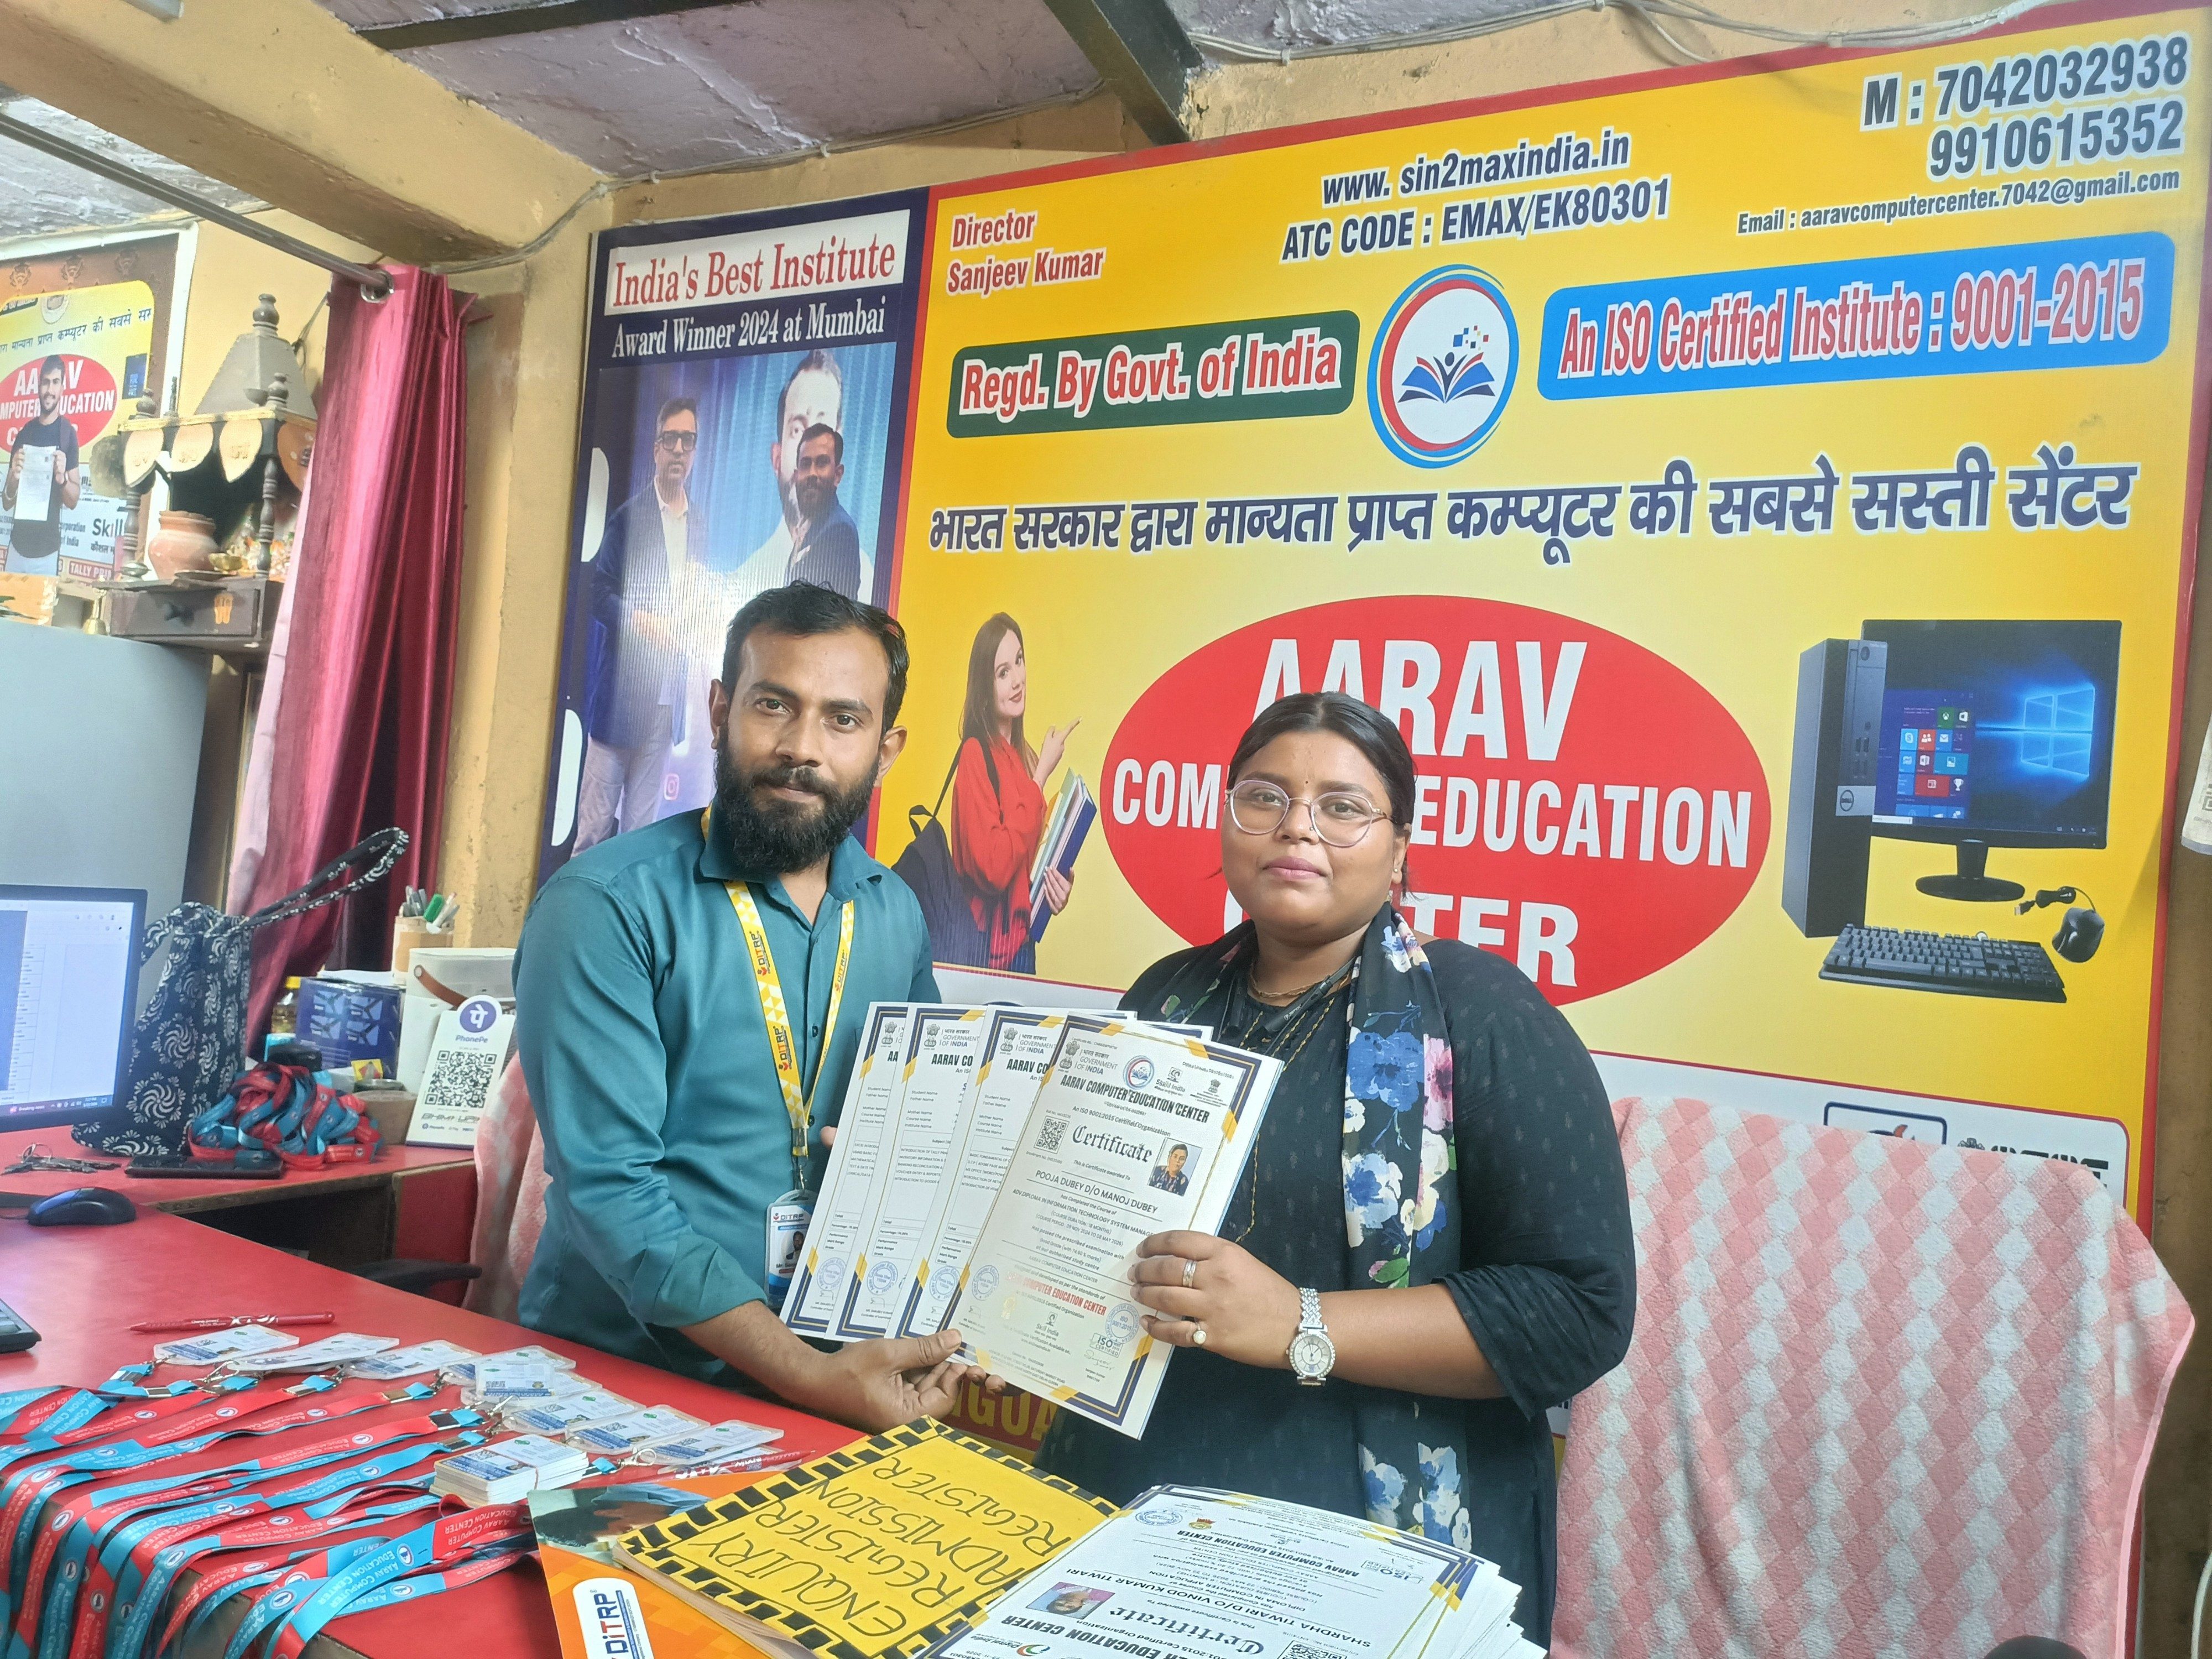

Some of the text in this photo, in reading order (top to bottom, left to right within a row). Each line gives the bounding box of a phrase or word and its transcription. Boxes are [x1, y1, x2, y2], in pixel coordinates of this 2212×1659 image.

[1864, 78, 1898, 127] M
[1938, 37, 2188, 116] 7042032938
[1931, 101, 2182, 176] 9910615352
[1324, 130, 1629, 203] www. sin2maxindia.in
[1282, 223, 1331, 259] ATC
[1341, 212, 1414, 253] CODE
[1442, 179, 1670, 242] EMAX/EK80301
[1738, 211, 1785, 233] Email
[1801, 170, 2179, 226] aaravcomputercenter.7042@gmail.com
[953, 211, 1036, 247] Director
[613, 233, 895, 307] India's Best Institute
[948, 249, 1104, 294] Sanjeev Kumar
[93, 317, 103, 331] की
[109, 309, 131, 327] सबसे
[612, 296, 886, 358] Award Winner 2024 at Mumbai
[1559, 309, 1597, 375] An
[1604, 302, 1651, 371] ISO
[1661, 290, 1782, 366] Certified
[1791, 287, 1921, 357] Institute
[1952, 264, 2143, 346] 9001-2015
[14, 359, 83, 397] AAV
[963, 330, 1338, 418] Regd. By Govt. of India
[0, 390, 114, 420] MPUTER UCATION
[929, 443, 2137, 565] भारत सरकार द्वारा मान्यता प्राप्त कम्प्यूटर की सबसे सस्ती सेंटर
[92, 518, 124, 538] Skill
[71, 563, 92, 576] TALLY
[1411, 777, 1751, 868] EDUCATION
[455, 1035, 488, 1043] PhonePe
[931, 1053, 961, 1066] AARAV
[1007, 1059, 1035, 1072] AARAV
[1079, 1056, 1117, 1070] GOVERNMENT
[1085, 1066, 1104, 1074] INDIA
[1061, 1075, 1085, 1089] AARAV
[1085, 1081, 1128, 1100] COMPUTER
[1128, 1092, 1175, 1113] EDUCATION
[1175, 1104, 1209, 1122] CENTER
[1071, 1124, 1155, 1162] Certificate
[1035, 1170, 1157, 1214] POOJA DUBEY D/O MANOJ DUBEY
[1052, 1288, 1107, 1315] EDUCATION CENTER
[1095, 1344, 1118, 1355] CERTIFIED
[1097, 1336, 1113, 1348] ISO
[444, 1518, 473, 1533] CENTER
[873, 1457, 1072, 1557] REGISTER
[448, 1525, 482, 1545] COMPUTER
[754, 1498, 965, 1609] REGISTER
[813, 1478, 1024, 1585] ADMISSION
[1177, 1530, 1359, 1577] AARAV COMPUTER EDUCATION CENTER
[316, 1575, 351, 1605] CENTER
[328, 1561, 399, 1608] AARAV COMPUTER
[686, 1531, 907, 1638] ENQUIRY
[1066, 1568, 1370, 1647] SHARDHA TIWARI D/O VINOD KUMAR TIWARI
[1001, 1615, 1160, 1658] EDUCATION CENTER
[1076, 1620, 1178, 1648] Certified Organization
[1109, 1607, 1263, 1655] Certificate
